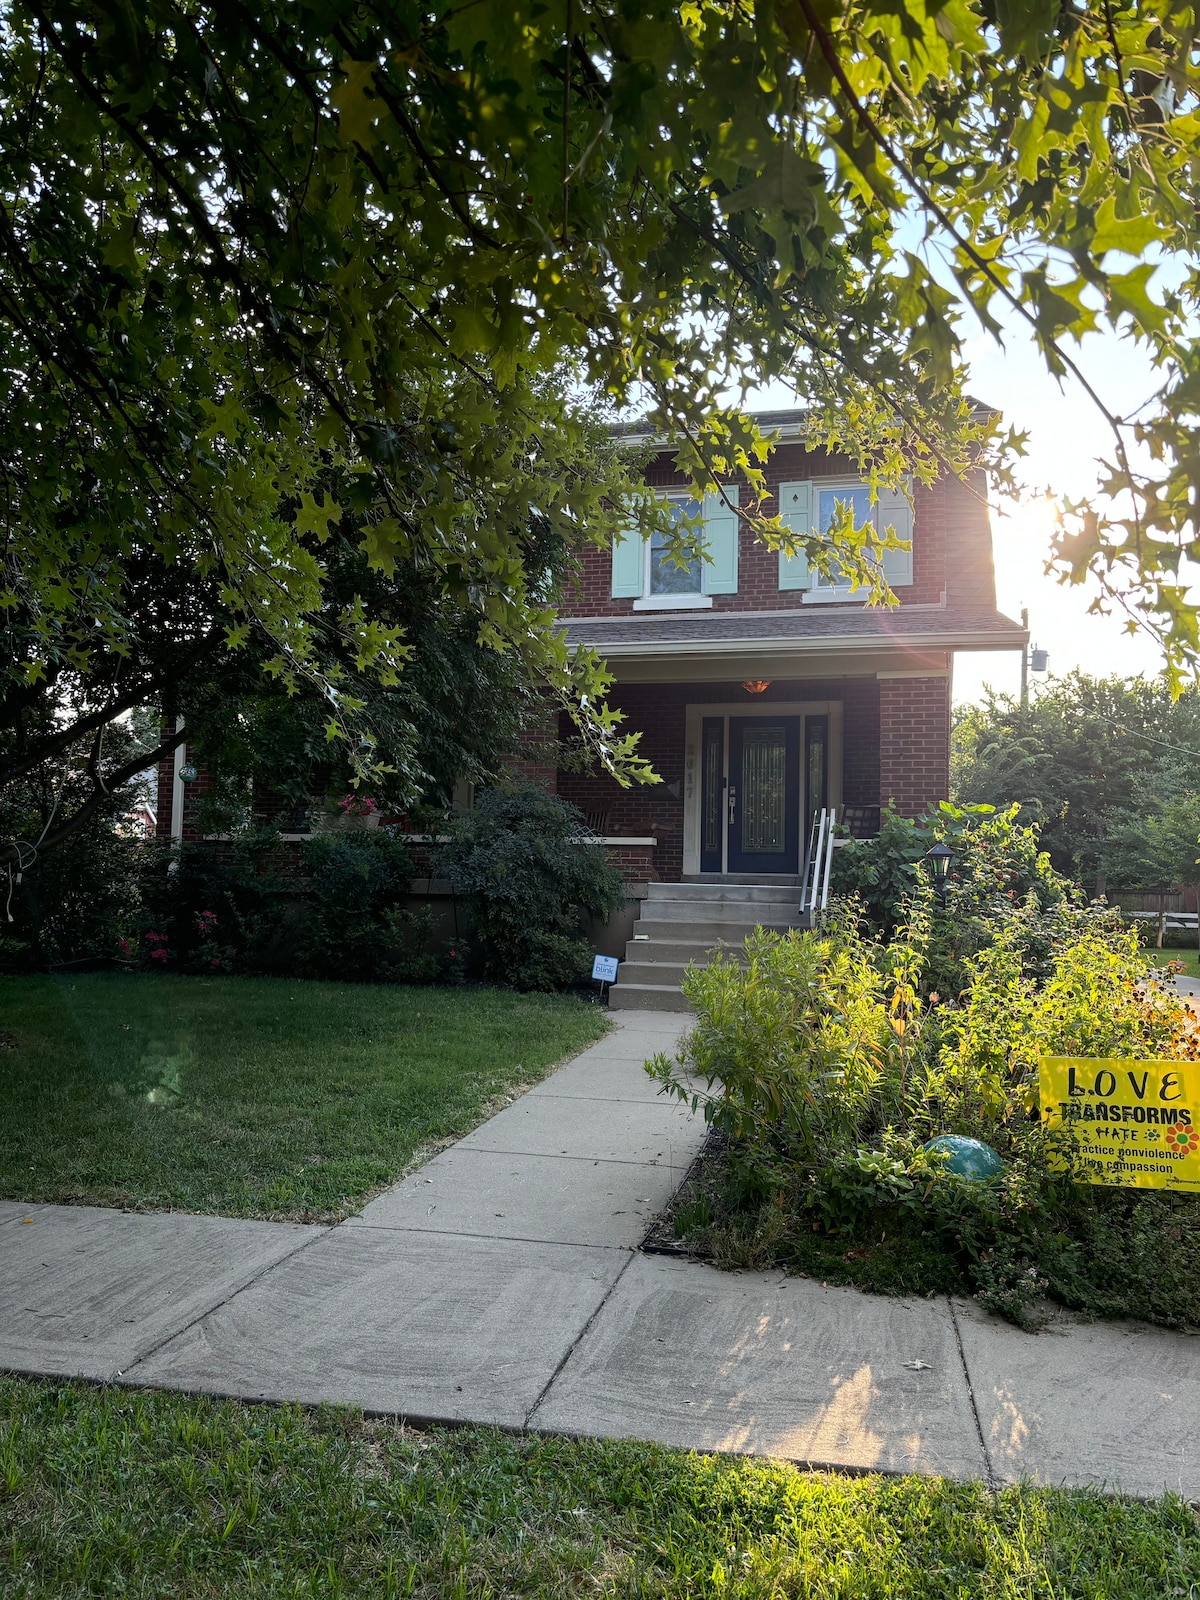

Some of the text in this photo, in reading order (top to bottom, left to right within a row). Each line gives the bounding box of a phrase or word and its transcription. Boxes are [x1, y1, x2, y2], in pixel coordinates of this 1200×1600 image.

[596, 964, 614, 975] blink
[1068, 1067, 1182, 1101] LOVE
[1058, 1102, 1192, 1126] TRANSFORMS
[1095, 1127, 1138, 1141] HATE
[1071, 1144, 1185, 1160] ractice nonviolence
[1106, 1161, 1173, 1174] compassion
